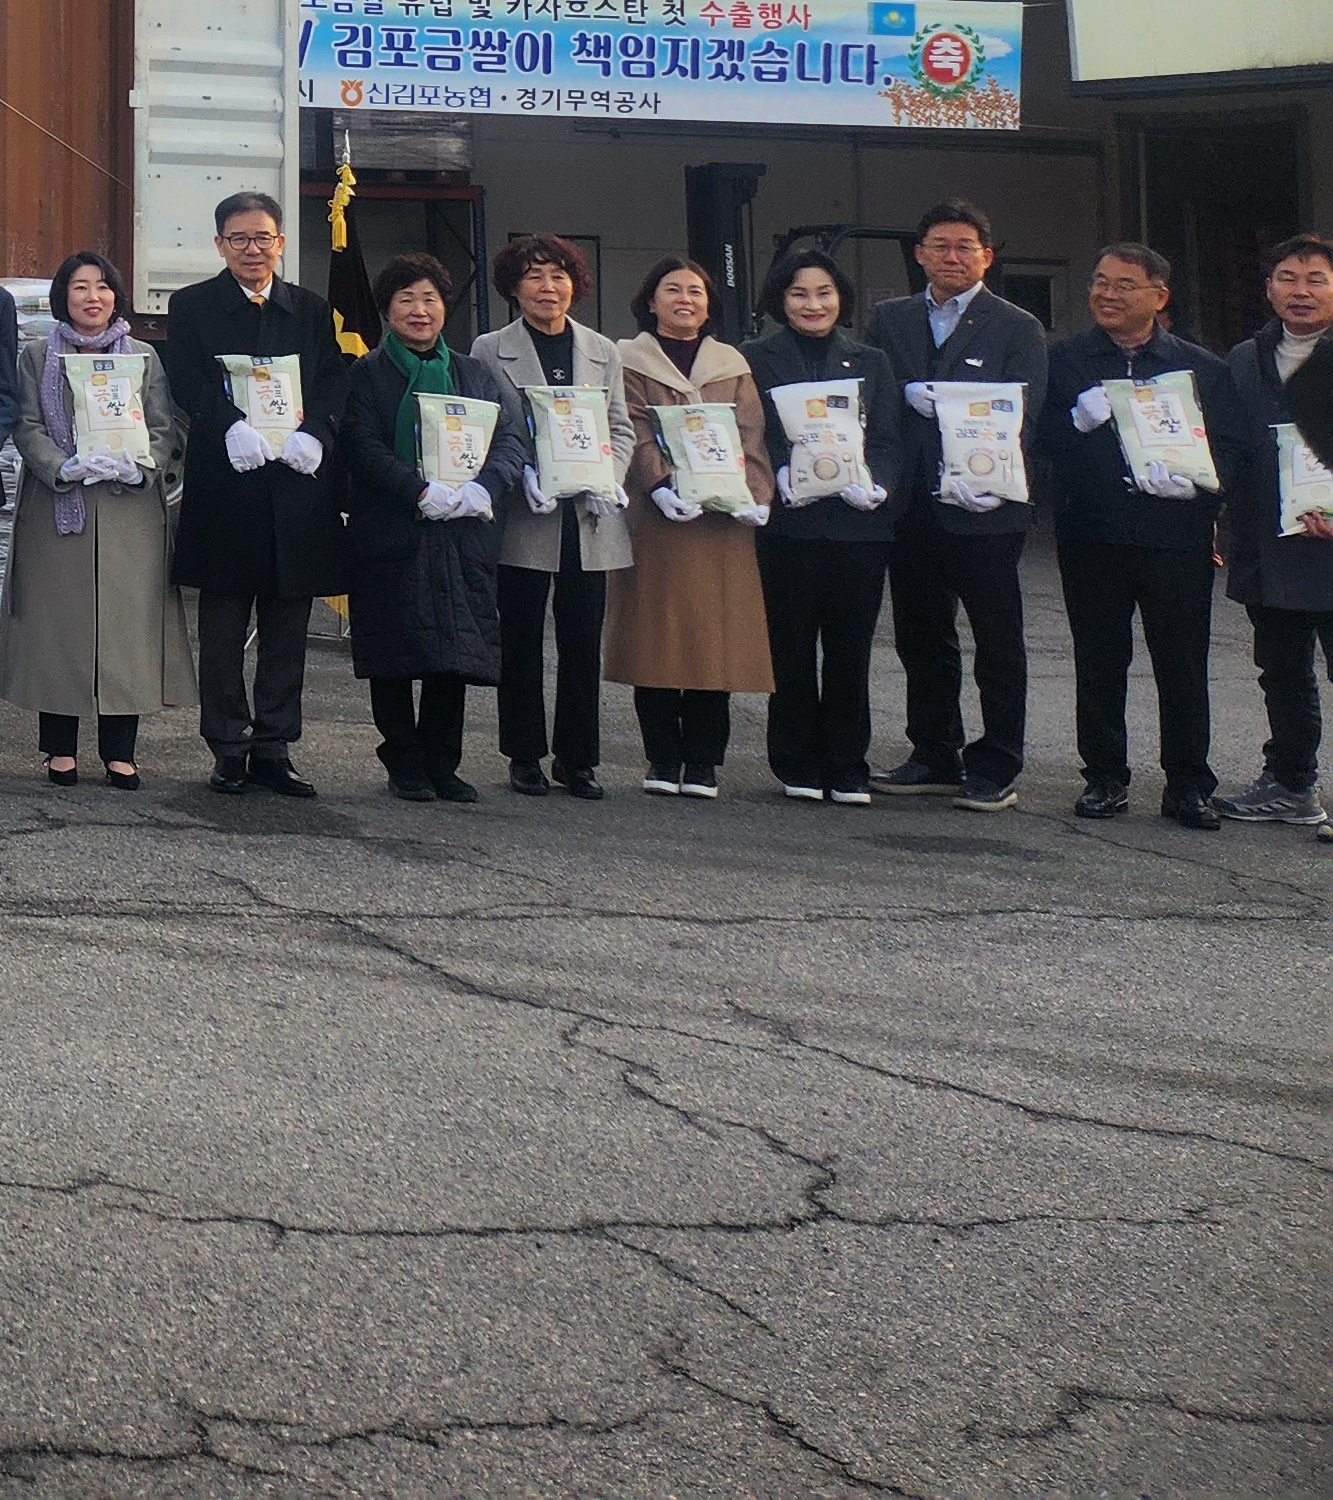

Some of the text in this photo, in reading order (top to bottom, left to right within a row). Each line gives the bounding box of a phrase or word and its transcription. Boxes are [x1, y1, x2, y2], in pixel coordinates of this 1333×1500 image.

[663, 0, 688, 27] 첫
[700, 0, 813, 31] 수출행사
[333, 26, 554, 77] 김포금쌀이
[572, 31, 895, 86] 책임지겠습니다.
[927, 40, 967, 78] 축
[365, 82, 662, 115] 신김포농협 경기무역공사
[724, 243, 735, 288] DOOSAN
